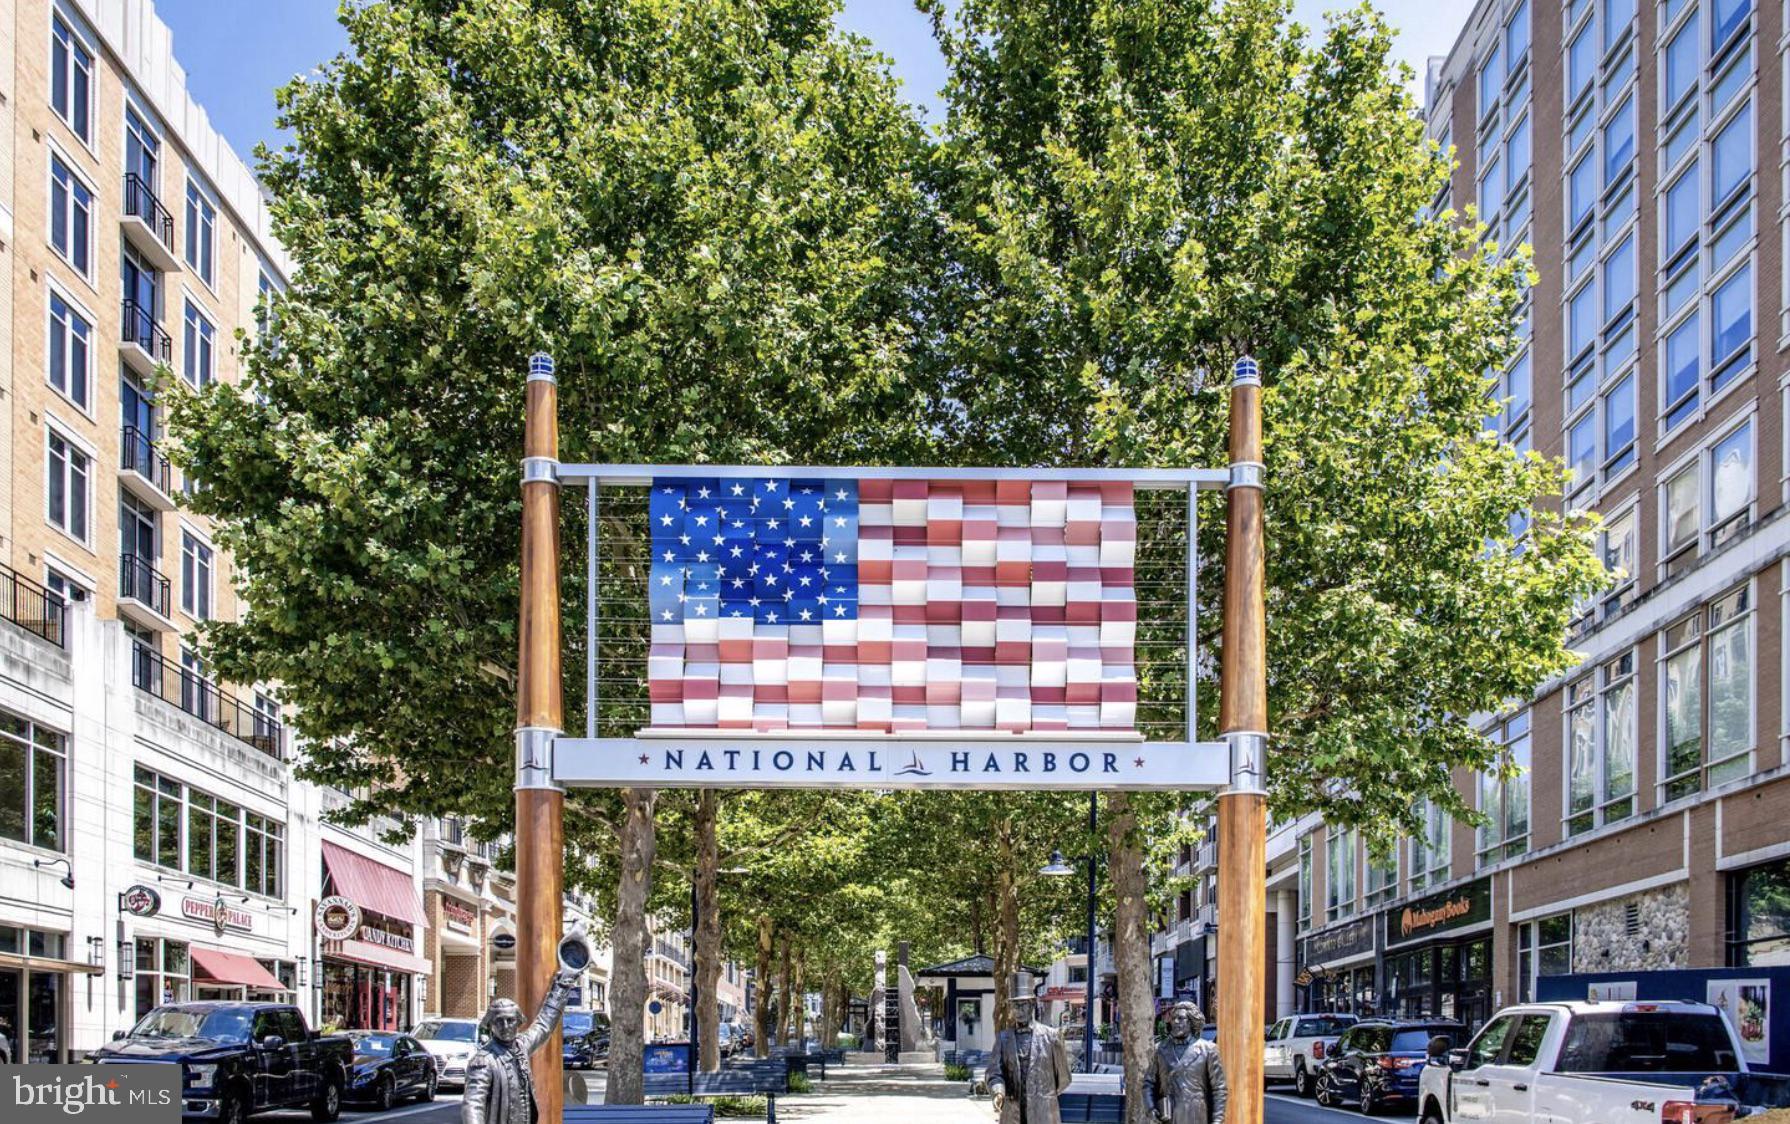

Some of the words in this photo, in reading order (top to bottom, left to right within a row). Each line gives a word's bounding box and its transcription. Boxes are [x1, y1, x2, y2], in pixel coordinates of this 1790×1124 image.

[664, 749, 882, 771] NATIONAL
[950, 751, 1119, 772] HARBOR
[185, 899, 214, 920] PEPPER
[227, 909, 252, 927] PALACE
[360, 926, 386, 944] CANDY
[386, 932, 414, 954] KITCHEN
